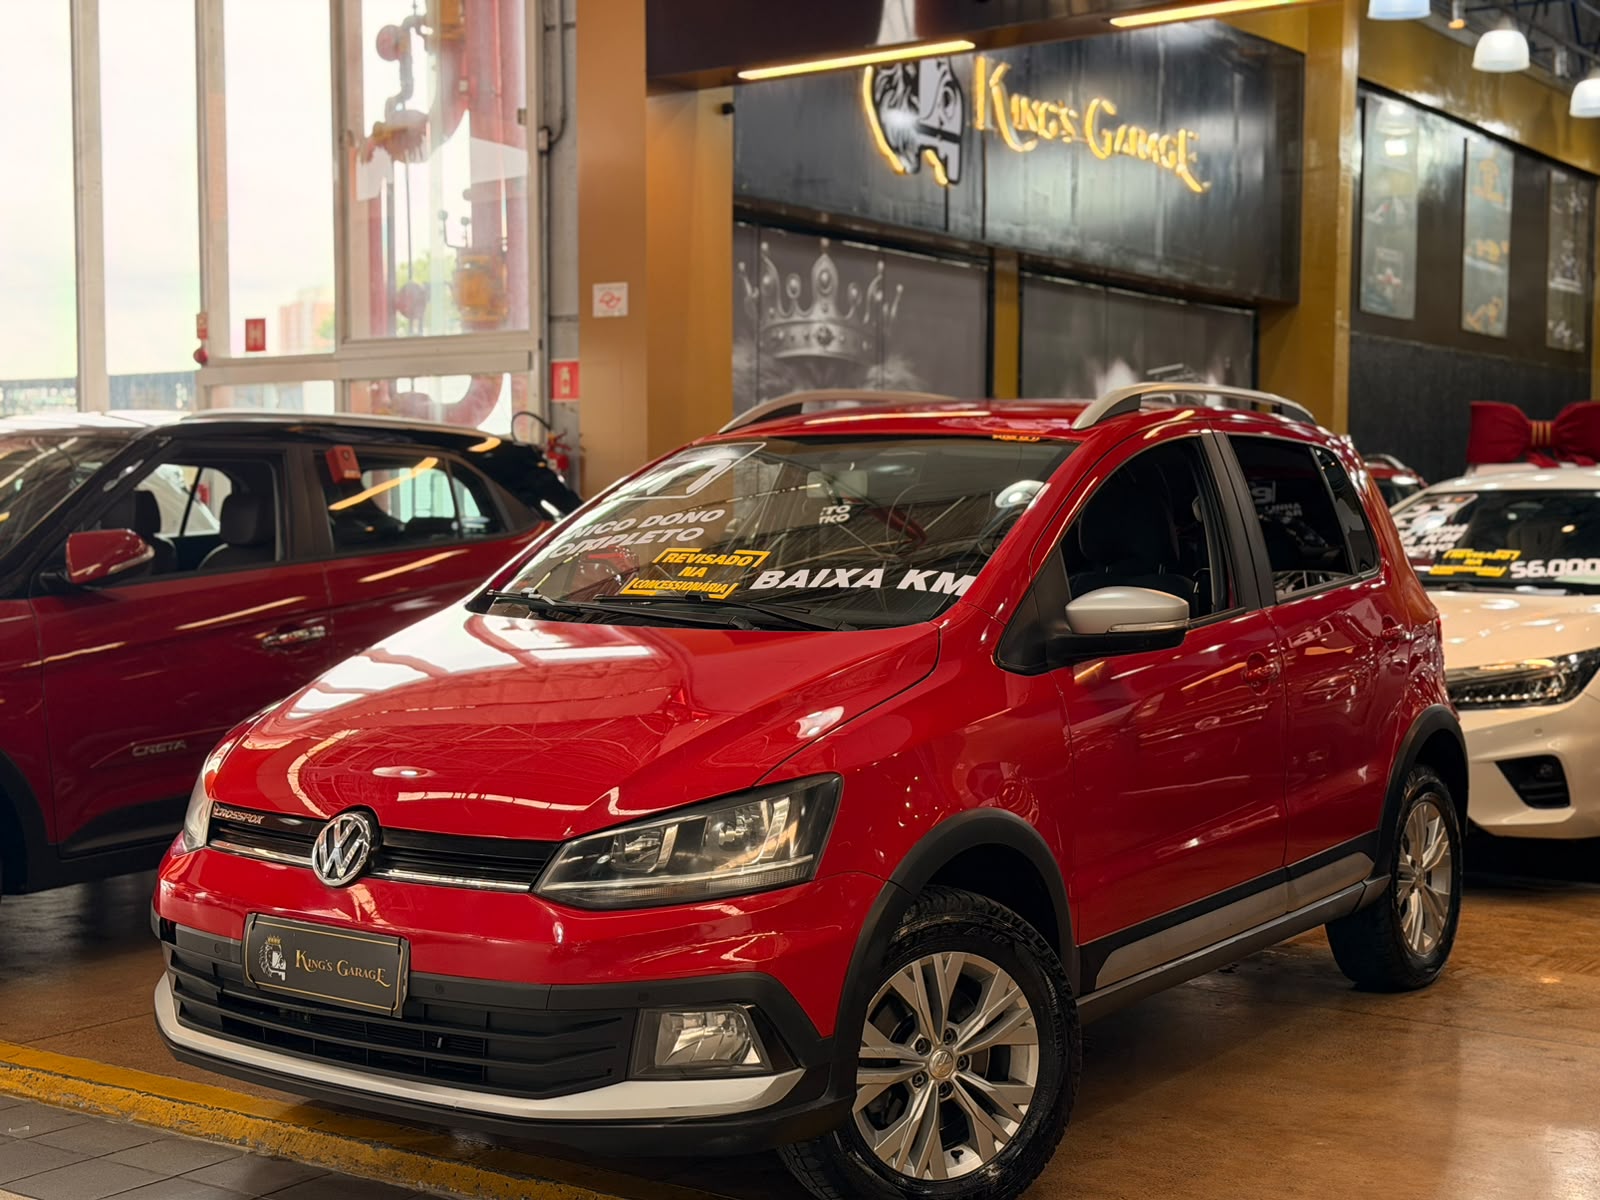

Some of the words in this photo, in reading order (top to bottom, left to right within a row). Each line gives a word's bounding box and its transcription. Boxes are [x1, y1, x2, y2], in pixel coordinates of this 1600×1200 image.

[553, 517, 637, 542] NICO
[638, 508, 726, 529] DONO
[546, 527, 705, 560] OMPLETO
[663, 551, 754, 568] REVISADO
[677, 566, 708, 578] NA
[748, 567, 885, 590] BAIXA
[896, 568, 978, 598] KM
[633, 577, 734, 595] CONCESSIONÁRIA
[131, 740, 187, 757] CRETA
[336, 959, 392, 988] GARAGE
